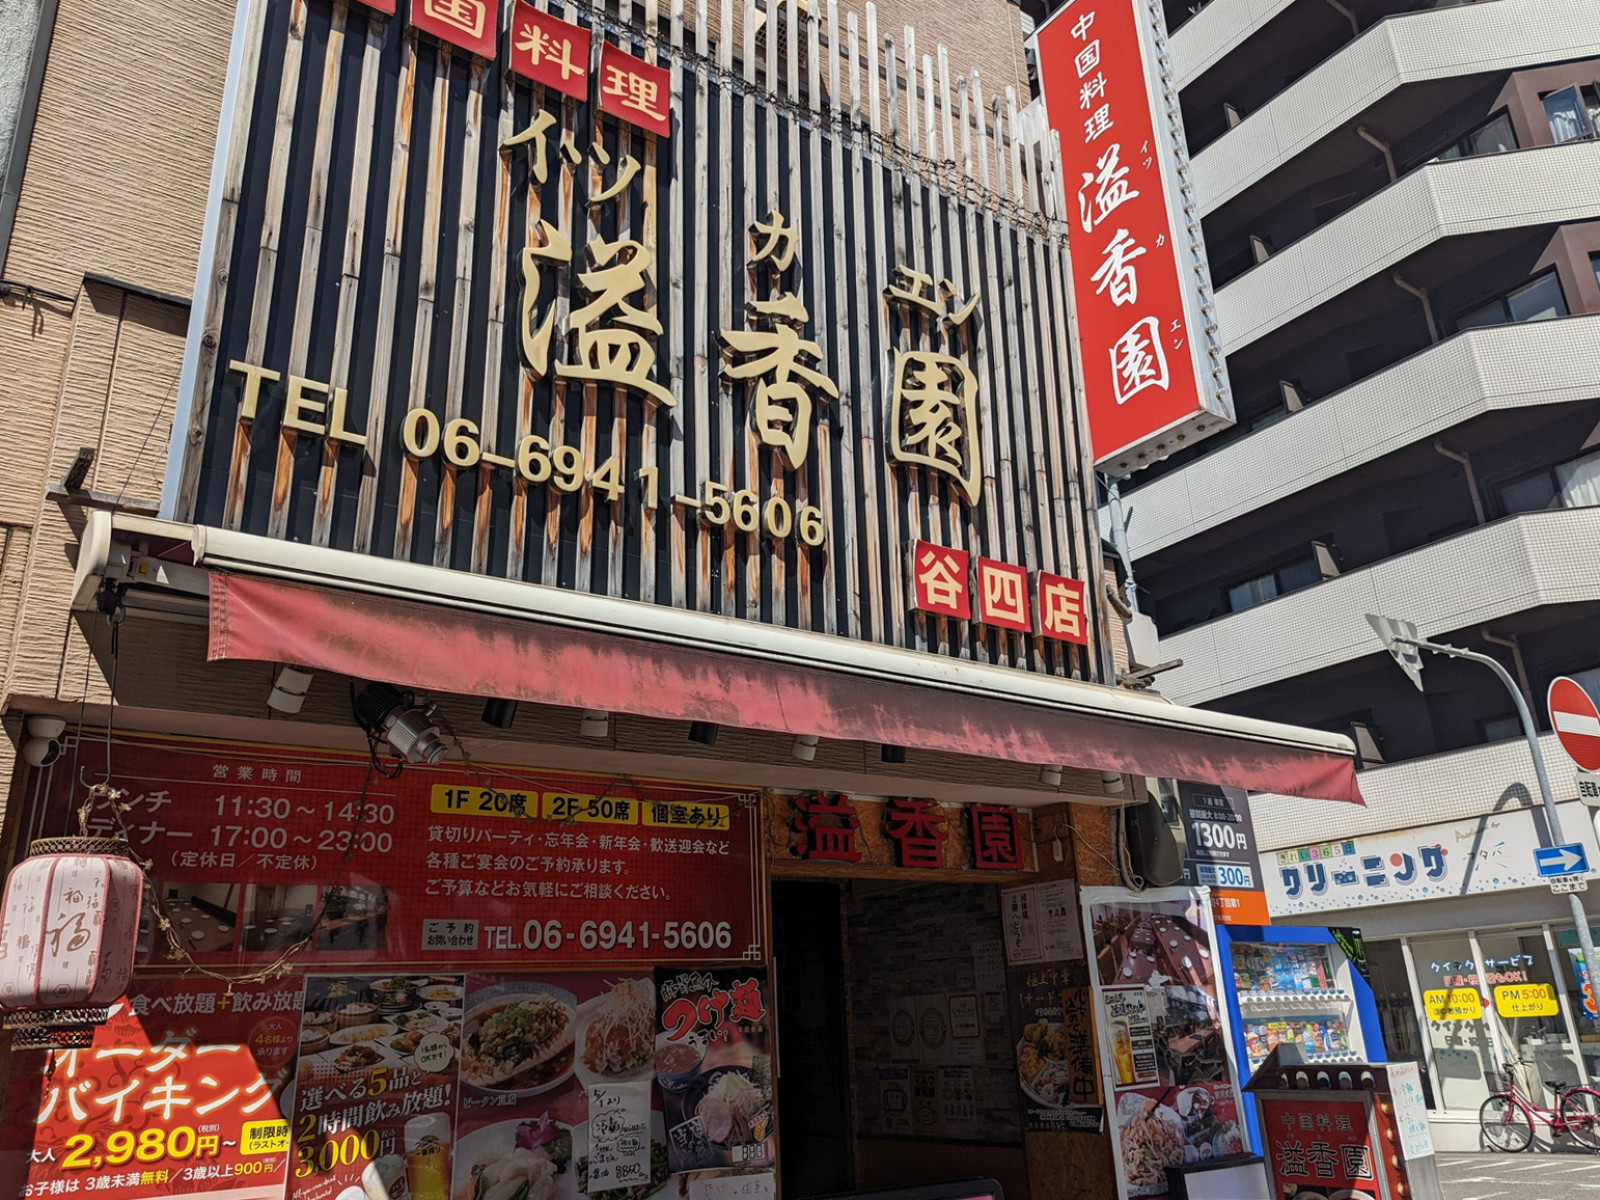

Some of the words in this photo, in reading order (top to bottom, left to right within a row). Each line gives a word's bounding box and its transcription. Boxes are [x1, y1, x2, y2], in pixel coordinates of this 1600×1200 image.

[1070, 11, 1115, 144] 中国料理
[751, 209, 799, 274] カ
[887, 263, 982, 326] エン
[1077, 143, 1171, 405] 溢香園
[1154, 233, 1166, 248] カ
[1169, 318, 1185, 351] エン
[520, 218, 982, 508] 溢香園
[228, 359, 368, 446] TEL
[402, 407, 825, 547] 06-6941-5606
[918, 550, 1081, 638] 谷四店
[212, 763, 303, 785] 営業時間
[444, 789, 471, 810] 1F
[552, 797, 579, 818] 2F
[587, 798, 631, 822] 50席
[793, 791, 1024, 871] 溢香園
[1191, 821, 1248, 850] 1300円
[1279, 845, 1449, 900] クリーニング
[1552, 882, 1586, 894] ここまで
[1429, 995, 1445, 1005] AM
[1447, 993, 1476, 1005] 10:00
[1502, 990, 1520, 1001] PM
[1523, 988, 1547, 1000] 5:00
[1512, 1003, 1544, 1012] 仕上がり
[34, 1069, 289, 1123] バイキング
[301, 1067, 423, 1113] 選べる5品と
[1281, 1112, 1353, 1133] 中国料理
[25, 1147, 56, 1164] 大人
[1276, 1140, 1374, 1181] 溢香園
